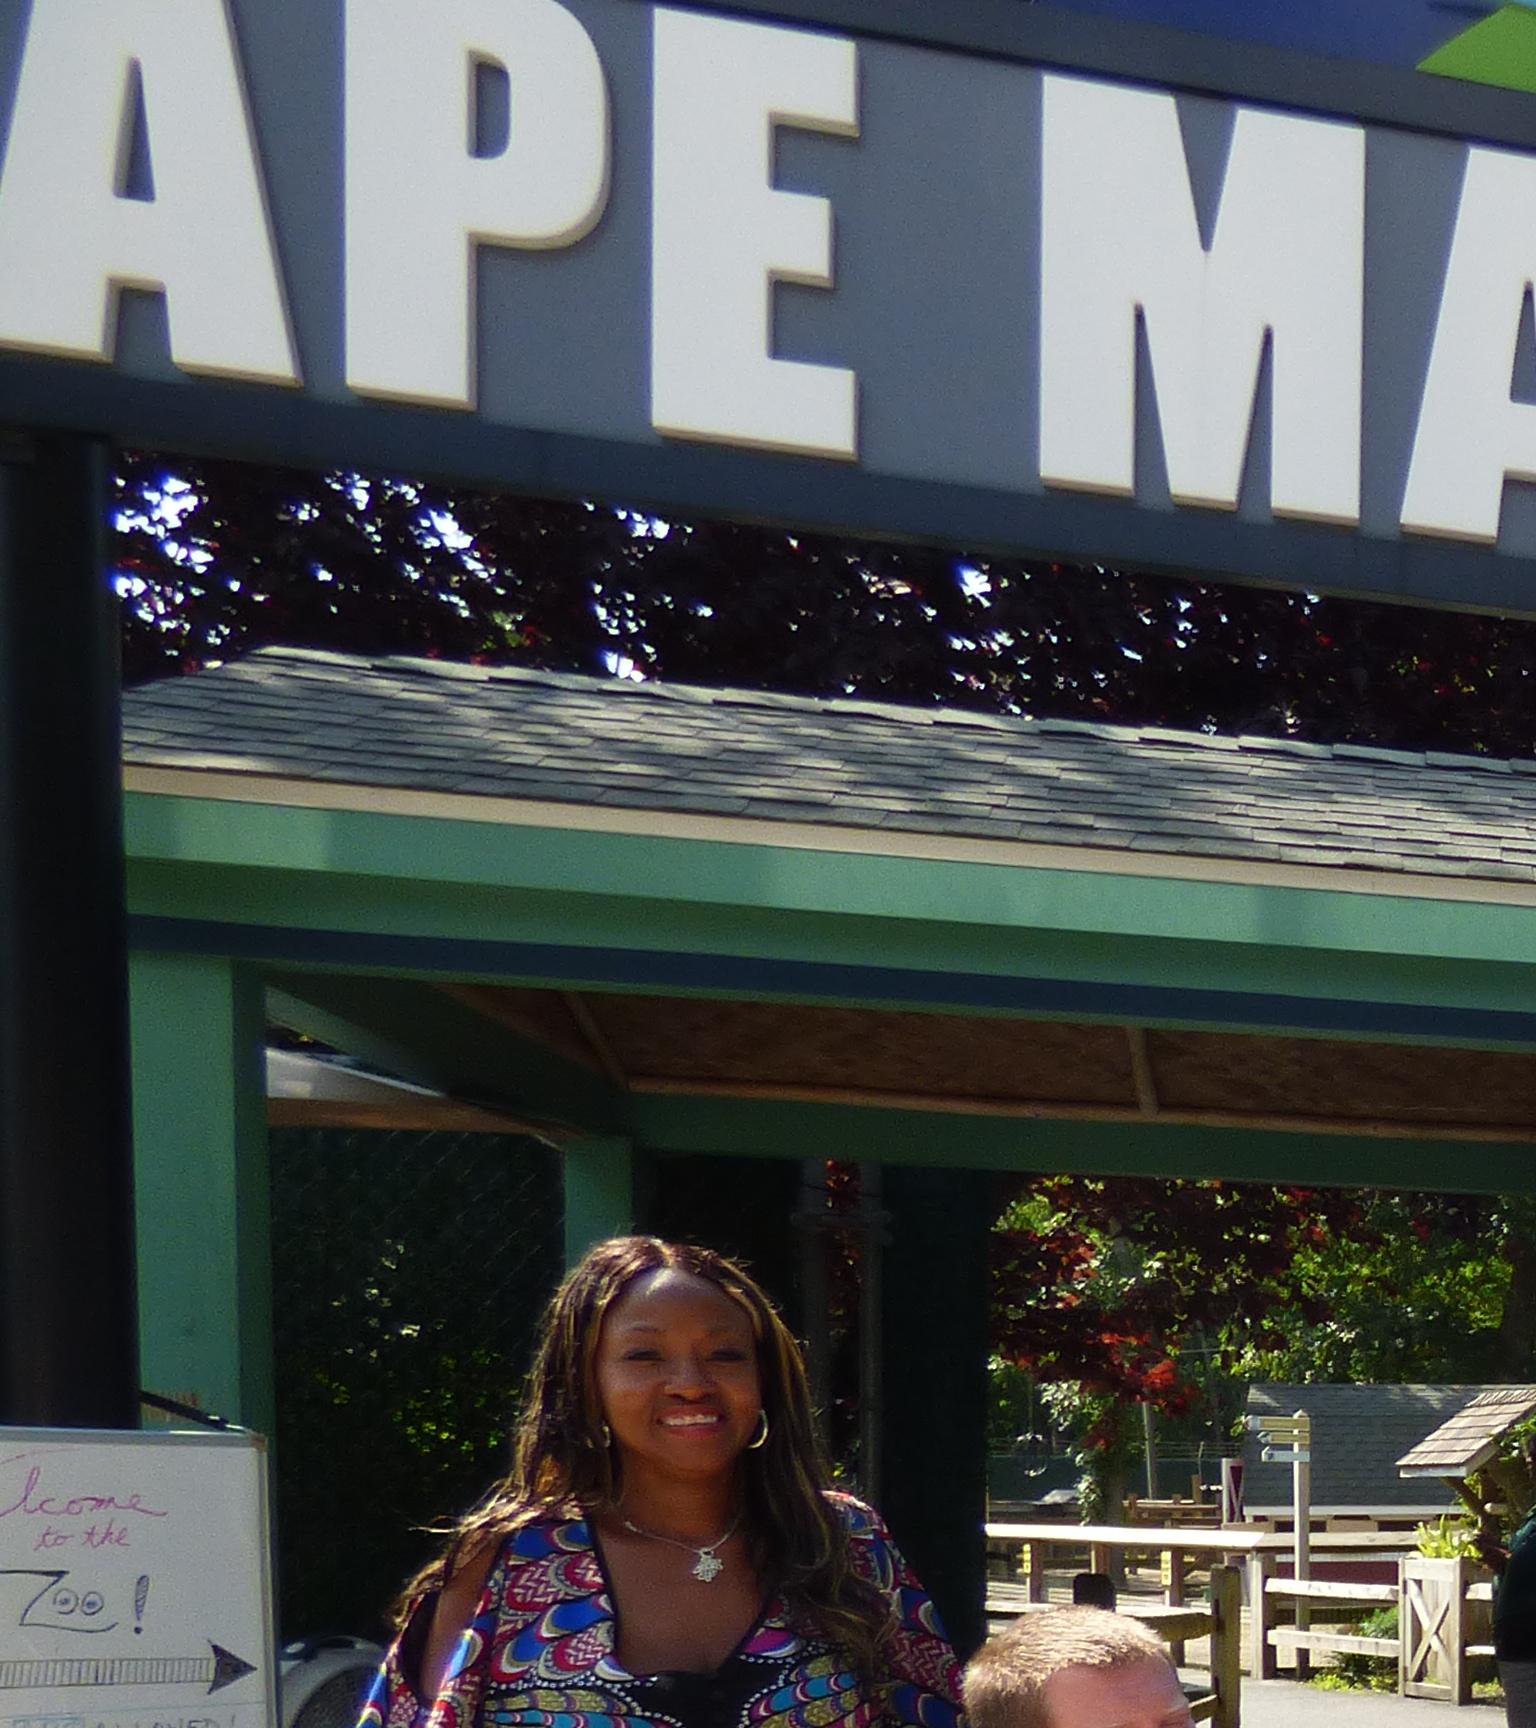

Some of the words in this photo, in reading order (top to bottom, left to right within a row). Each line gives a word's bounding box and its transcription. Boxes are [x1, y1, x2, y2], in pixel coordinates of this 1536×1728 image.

[0, 0, 860, 462] APE
[0, 1465, 168, 1518] lcome
[34, 1526, 76, 1550] to
[81, 1518, 130, 1548] the
